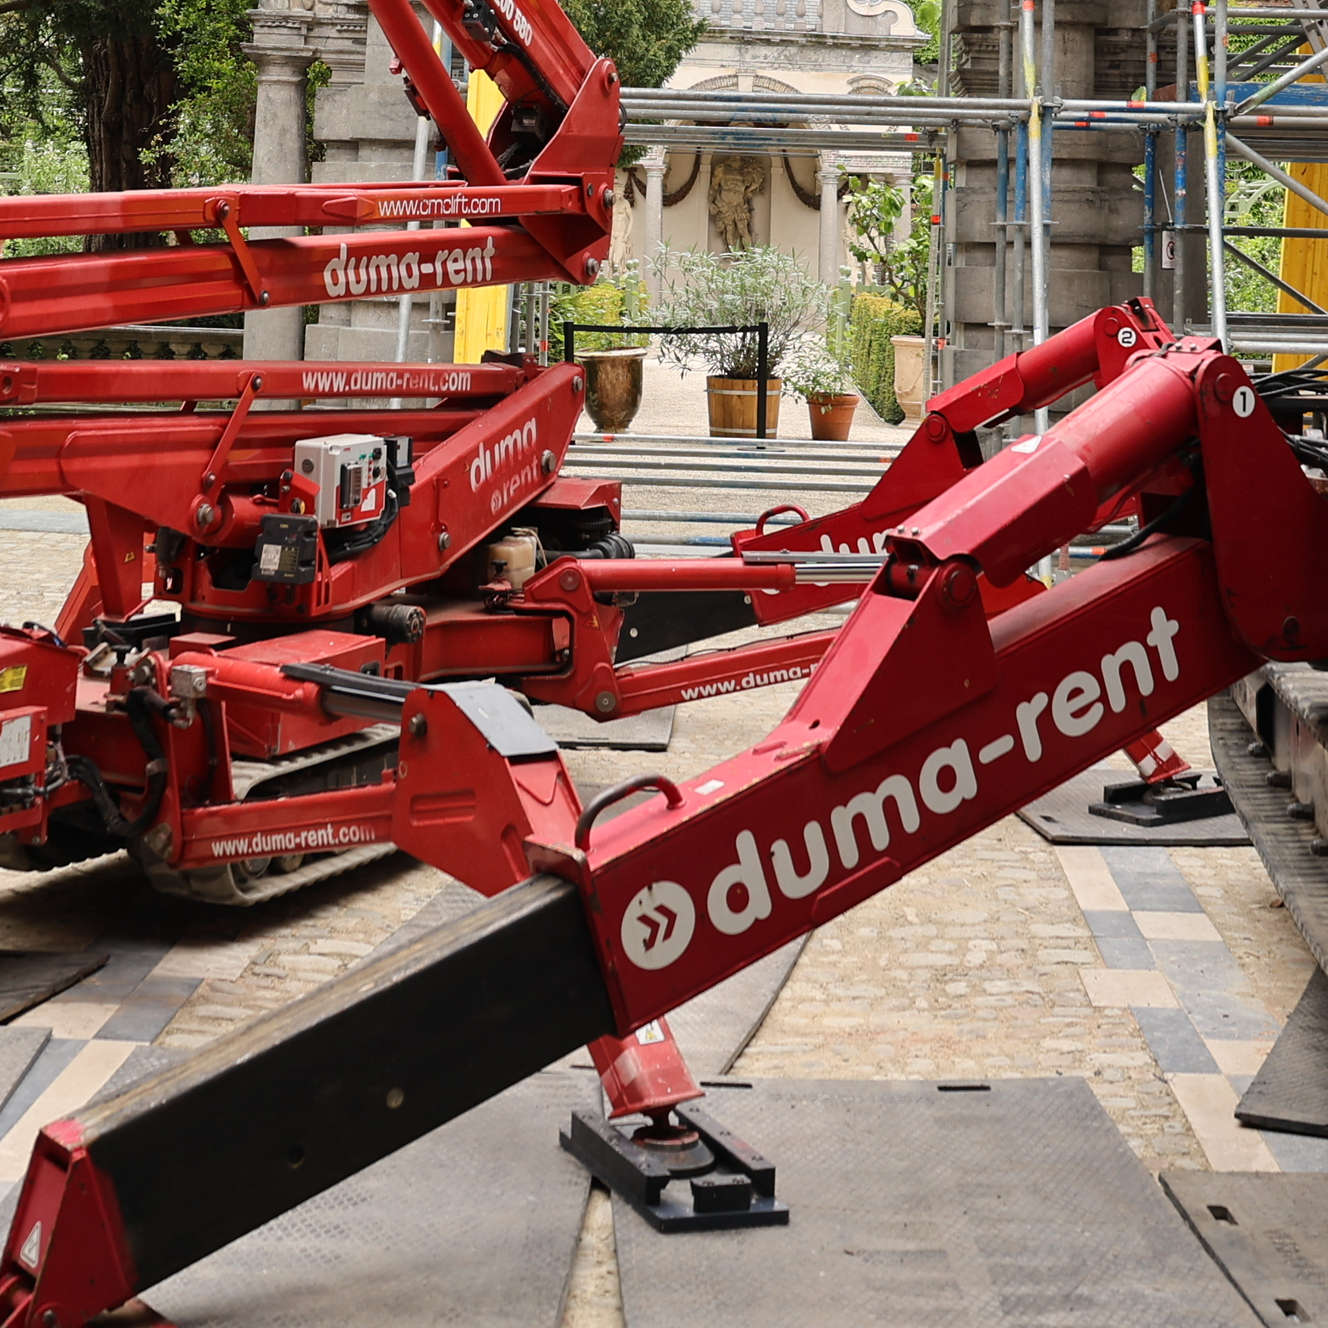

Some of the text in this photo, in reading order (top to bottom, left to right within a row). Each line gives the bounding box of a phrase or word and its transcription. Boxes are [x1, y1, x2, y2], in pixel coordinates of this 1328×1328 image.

[323, 235, 496, 298] duma-rent
[1121, 330, 1133, 344] 2
[301, 371, 471, 393] www.duma-rent.com
[469, 417, 538, 493] duma
[502, 459, 541, 504] rent
[707, 606, 1179, 935] duma-rent
[211, 822, 375, 857] www.duma-rent.com
